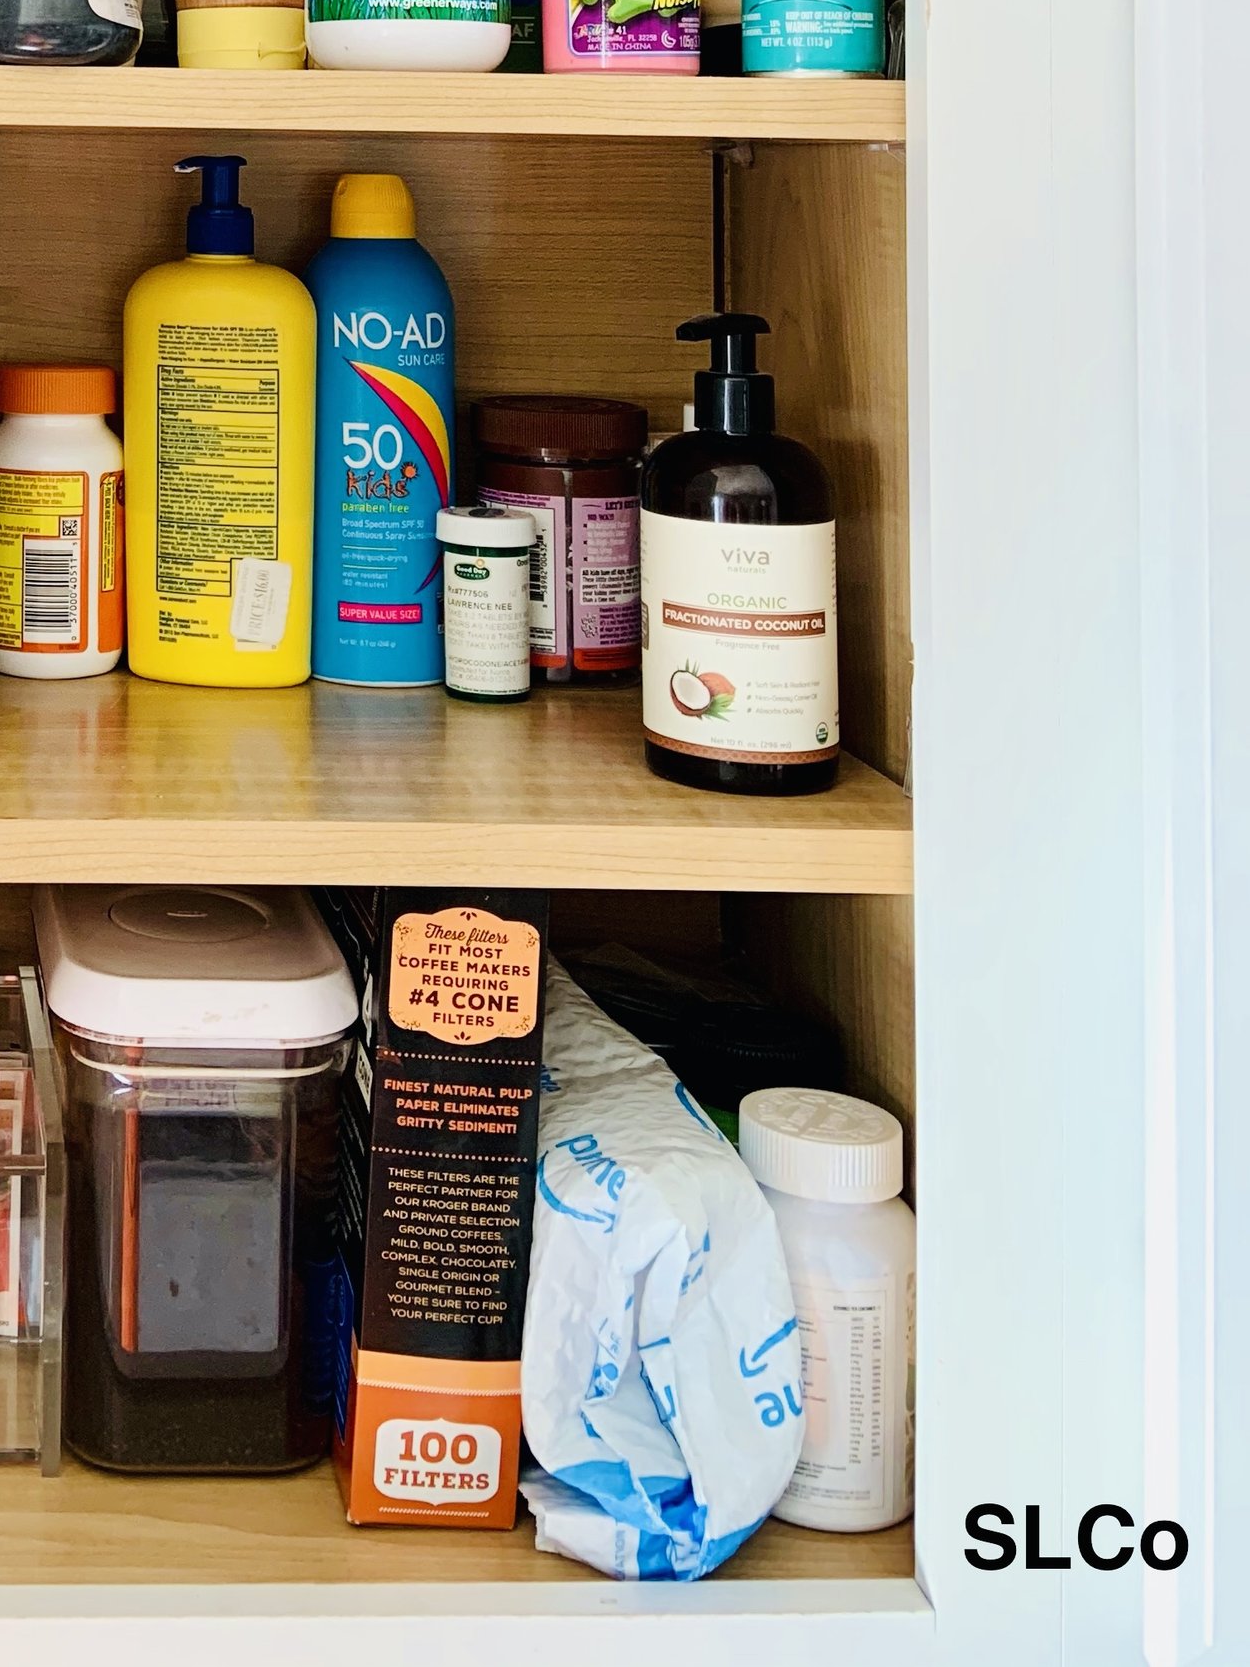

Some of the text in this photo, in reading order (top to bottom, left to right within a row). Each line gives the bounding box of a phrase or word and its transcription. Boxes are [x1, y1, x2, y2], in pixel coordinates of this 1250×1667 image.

[785, 22, 823, 34] WARNING:
[625, 42, 652, 50] CHINA
[333, 311, 446, 350] NO-AD
[398, 353, 445, 366] SUN CARE
[342, 422, 403, 470] 50
[342, 502, 410, 513] paraben free
[342, 518, 424, 529] Broad Spectrum SPF 50
[721, 548, 771, 566] viva
[727, 565, 766, 574] naturals
[707, 592, 787, 610] ORGANIC
[339, 607, 368, 619] SUPER
[369, 609, 397, 620] VALUE
[664, 608, 824, 631] FRACTIONATED COCONUT OIL
[425, 923, 510, 946] These filters
[429, 943, 503, 959] FIT MOST
[399, 956, 530, 976] COFFEE MAKERS
[422, 974, 509, 991] REQUIRING
[409, 989, 519, 1013] #4 CONE
[433, 1012, 495, 1027] FILTERS
[384, 1079, 533, 1100] FINEST NATURAL PULP
[396, 1098, 519, 1117] PAPER ELIMINATES
[388, 1167, 520, 1185] THESE FILTERS ARE THE
[383, 1209, 520, 1227] AND PRIVATE SELECTION
[390, 1308, 503, 1324] YOUR PERFECT CUP!
[399, 1430, 478, 1465] 100
[383, 1467, 489, 1490] FILTERS
